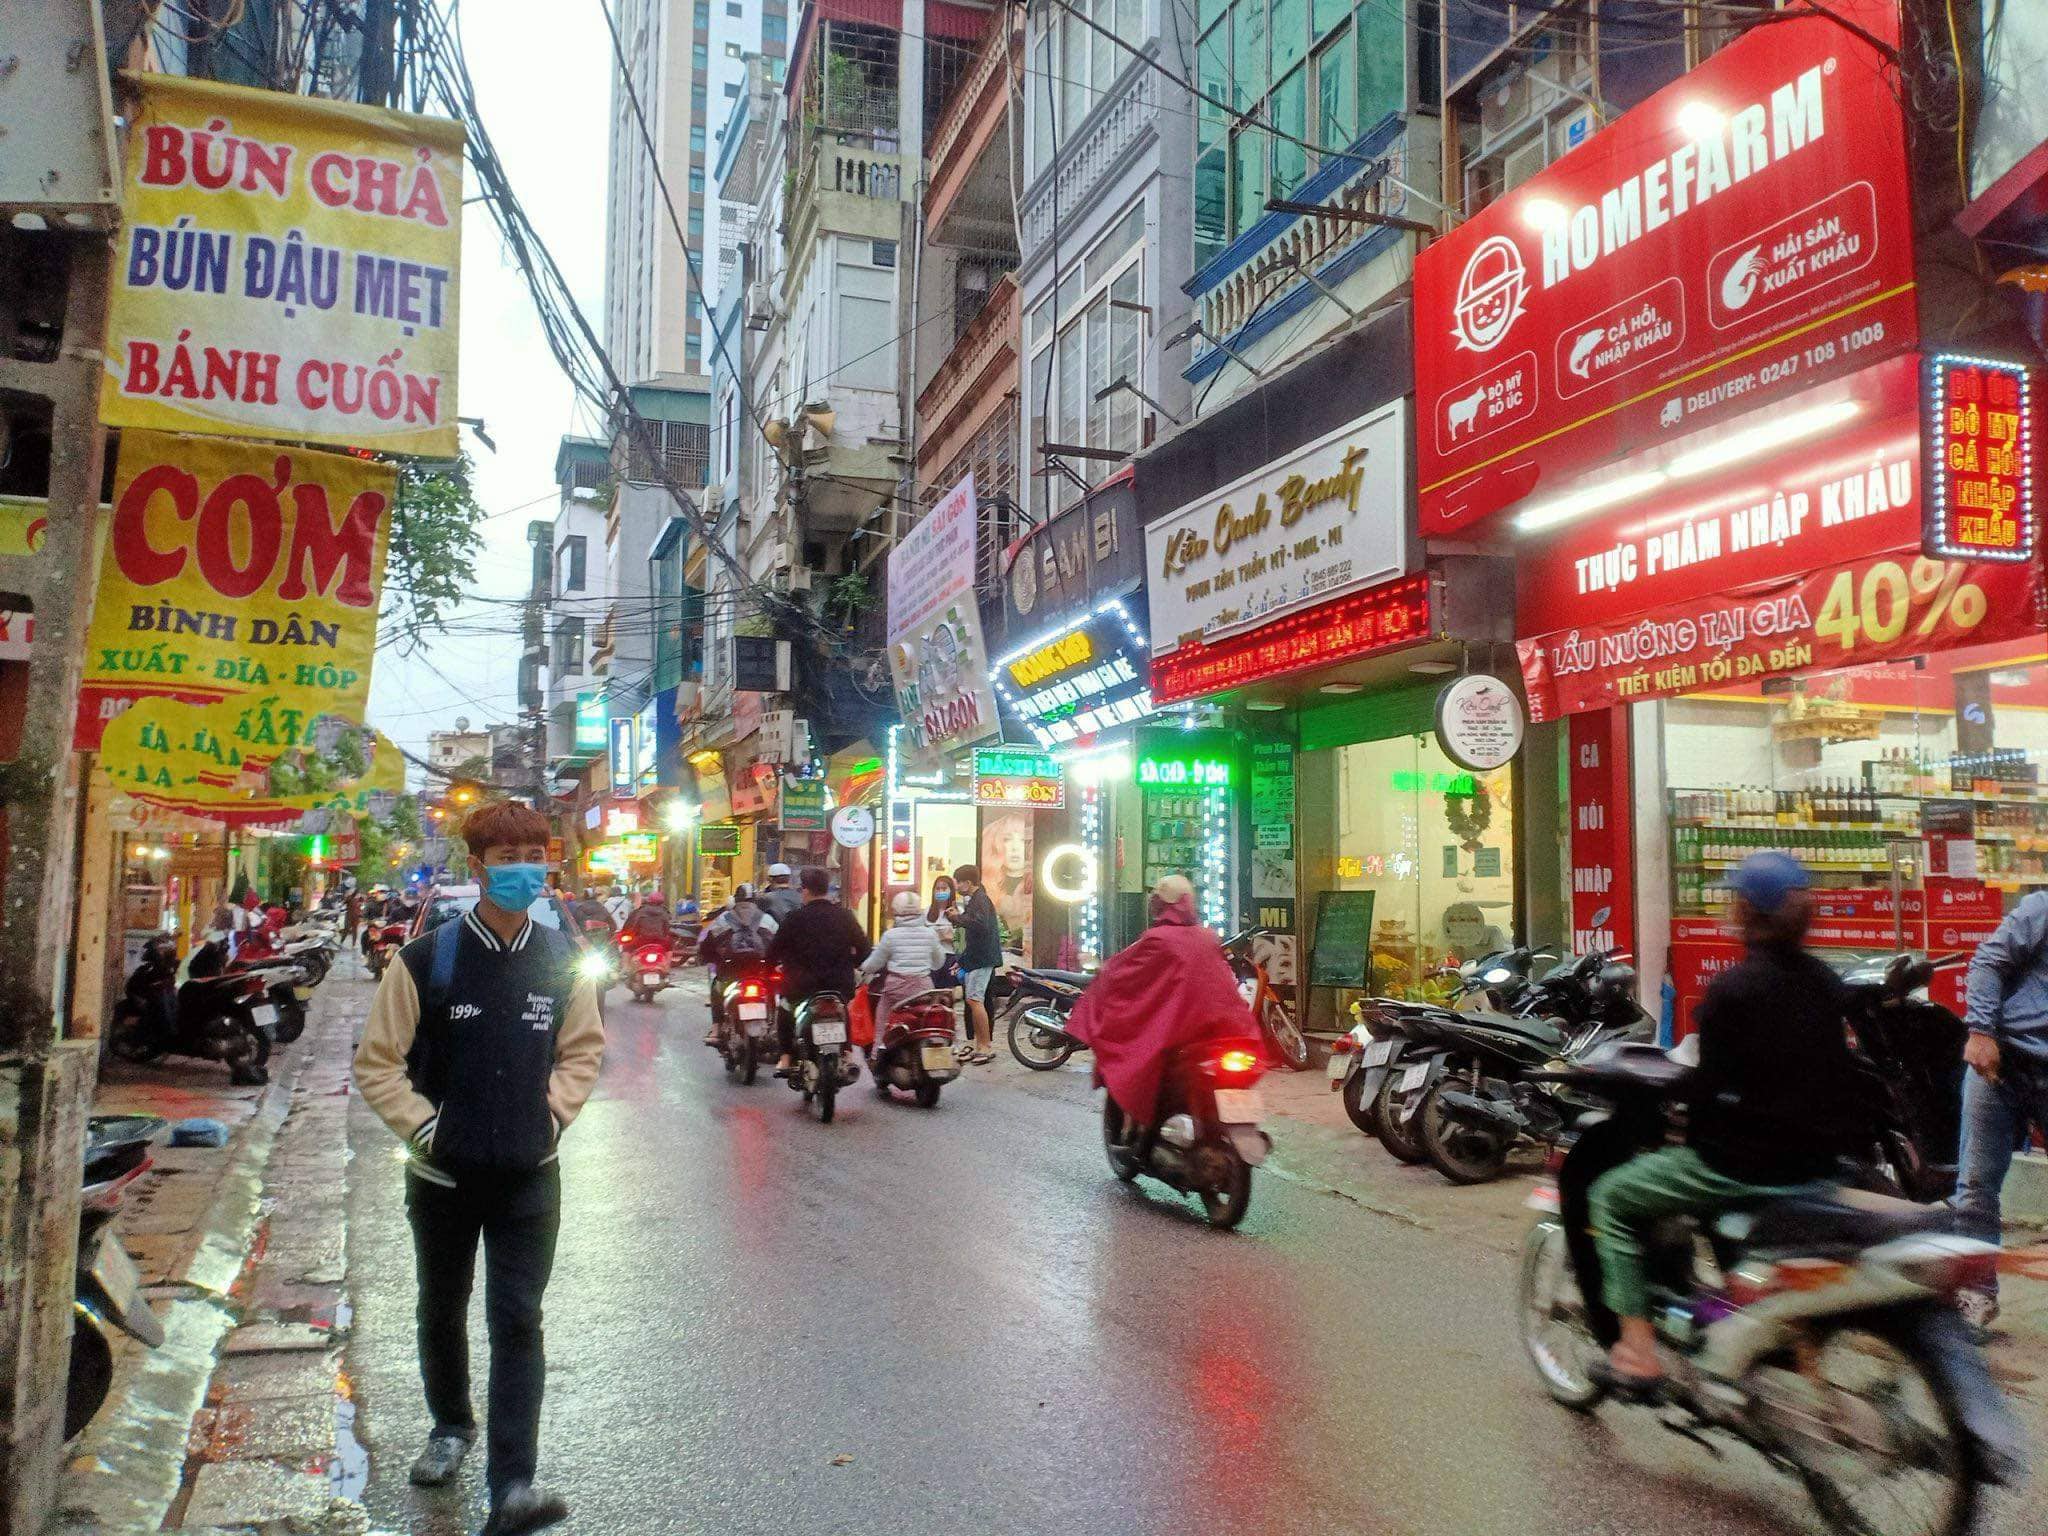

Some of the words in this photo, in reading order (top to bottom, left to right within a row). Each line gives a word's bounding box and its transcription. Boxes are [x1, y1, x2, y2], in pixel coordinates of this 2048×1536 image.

[141, 119, 293, 196] BÚN
[311, 147, 448, 226] CHẢ
[1542, 65, 1825, 289] HOMEFARM
[1762, 257, 1806, 294] XUẤT
[1811, 231, 1860, 272] KHẨU
[1773, 233, 1802, 263] HẢI
[1804, 216, 1841, 246] SẢN
[128, 218, 231, 294] BÚN
[245, 230, 340, 319] ĐẬU
[355, 254, 448, 337] MẸT
[1608, 317, 1629, 343] CÁ
[1631, 303, 1657, 333] HỒI
[125, 329, 281, 405] BÁNH
[297, 348, 440, 424] CUỐN
[1594, 340, 1632, 370] NHẬP
[1687, 374, 1757, 413] DELIVERY:
[1761, 356, 1799, 386] 0247
[1804, 341, 1835, 368] 108
[1841, 322, 1885, 353] 1008
[1506, 391, 1524, 410] ÚC
[1949, 438, 1980, 473] CÁ
[112, 454, 386, 607] CƠM
[1575, 542, 1638, 595] THỰC
[1730, 491, 1809, 549] NHẬP
[1821, 448, 1912, 527] KHẨU
[128, 599, 239, 641] BÌNH
[248, 612, 341, 648] DÂN
[1815, 558, 1988, 649] 40%
[98, 642, 190, 674] XUẤT
[213, 656, 271, 685] ĐĨA
[1553, 630, 1596, 676] LẨU
[1600, 613, 1697, 666] NƯỚNG
[1700, 607, 1745, 652] TẠI
[1751, 594, 1812, 637] GIA
[1616, 666, 1650, 697] TIẾT
[1654, 661, 1697, 693] KIỆM
[1701, 653, 1733, 687] TỐI
[1737, 652, 1766, 676] ĐA
[1769, 637, 1813, 670] ĐẾN
[1581, 739, 1599, 768] CÁ
[1579, 798, 1604, 830] HỒI
[1574, 863, 1613, 896] NHẬP
